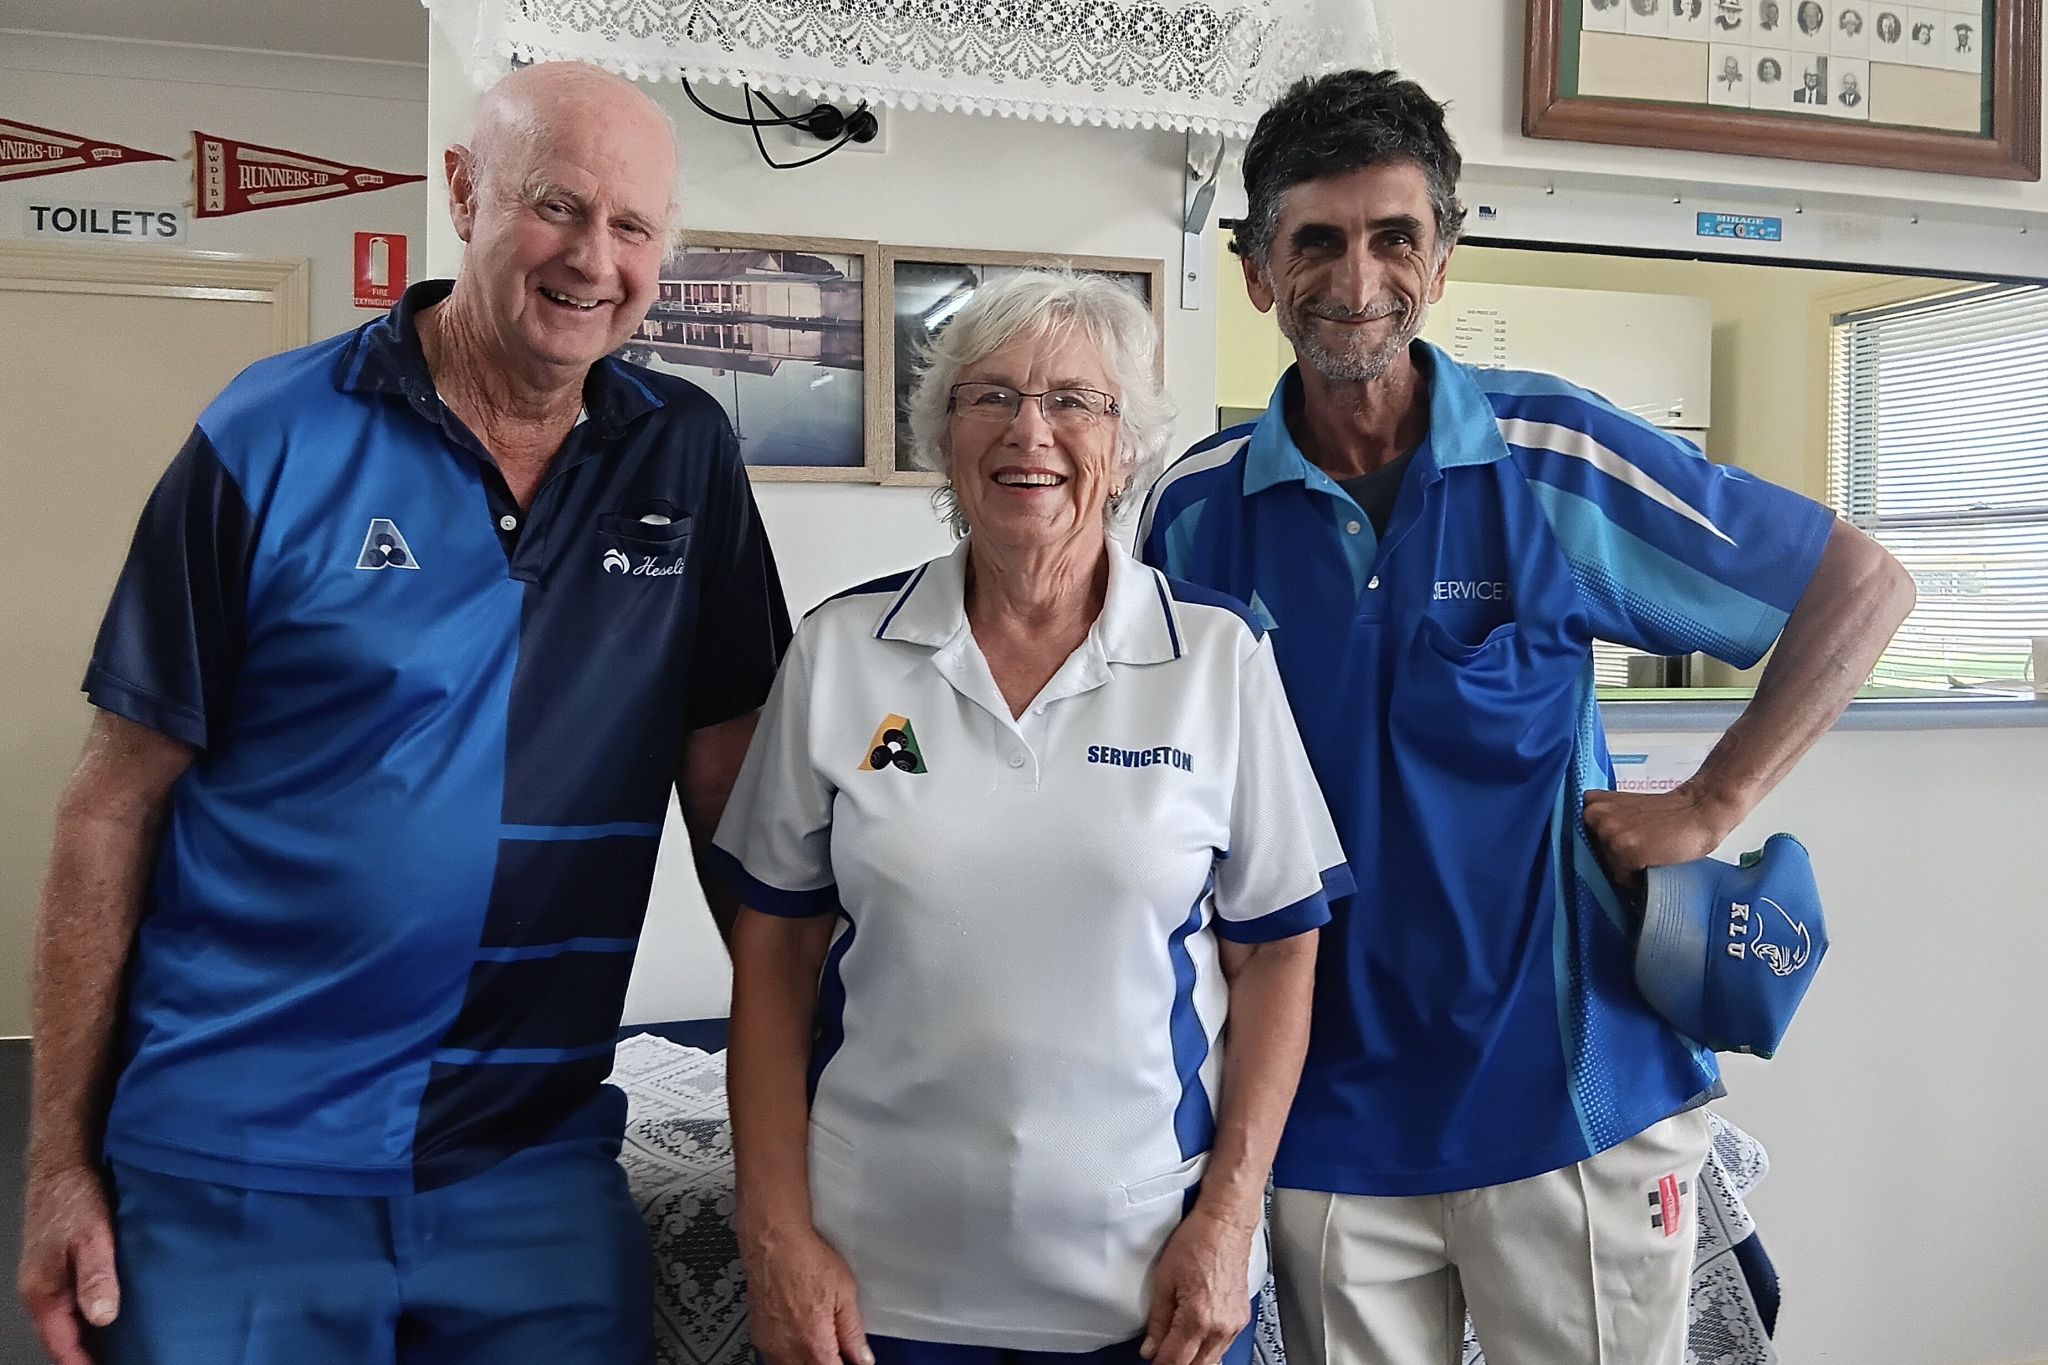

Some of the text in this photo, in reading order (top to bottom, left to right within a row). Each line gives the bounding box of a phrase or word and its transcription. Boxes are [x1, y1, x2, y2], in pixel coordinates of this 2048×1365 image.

[238, 165, 329, 189] RUNNERS-UP
[30, 206, 177, 237] TOILETS
[1716, 215, 1764, 225] MIRAGE
[372, 288, 389, 297] FIRE
[1433, 581, 1509, 600] SERVICE
[1087, 745, 1194, 774] SERVICETON
